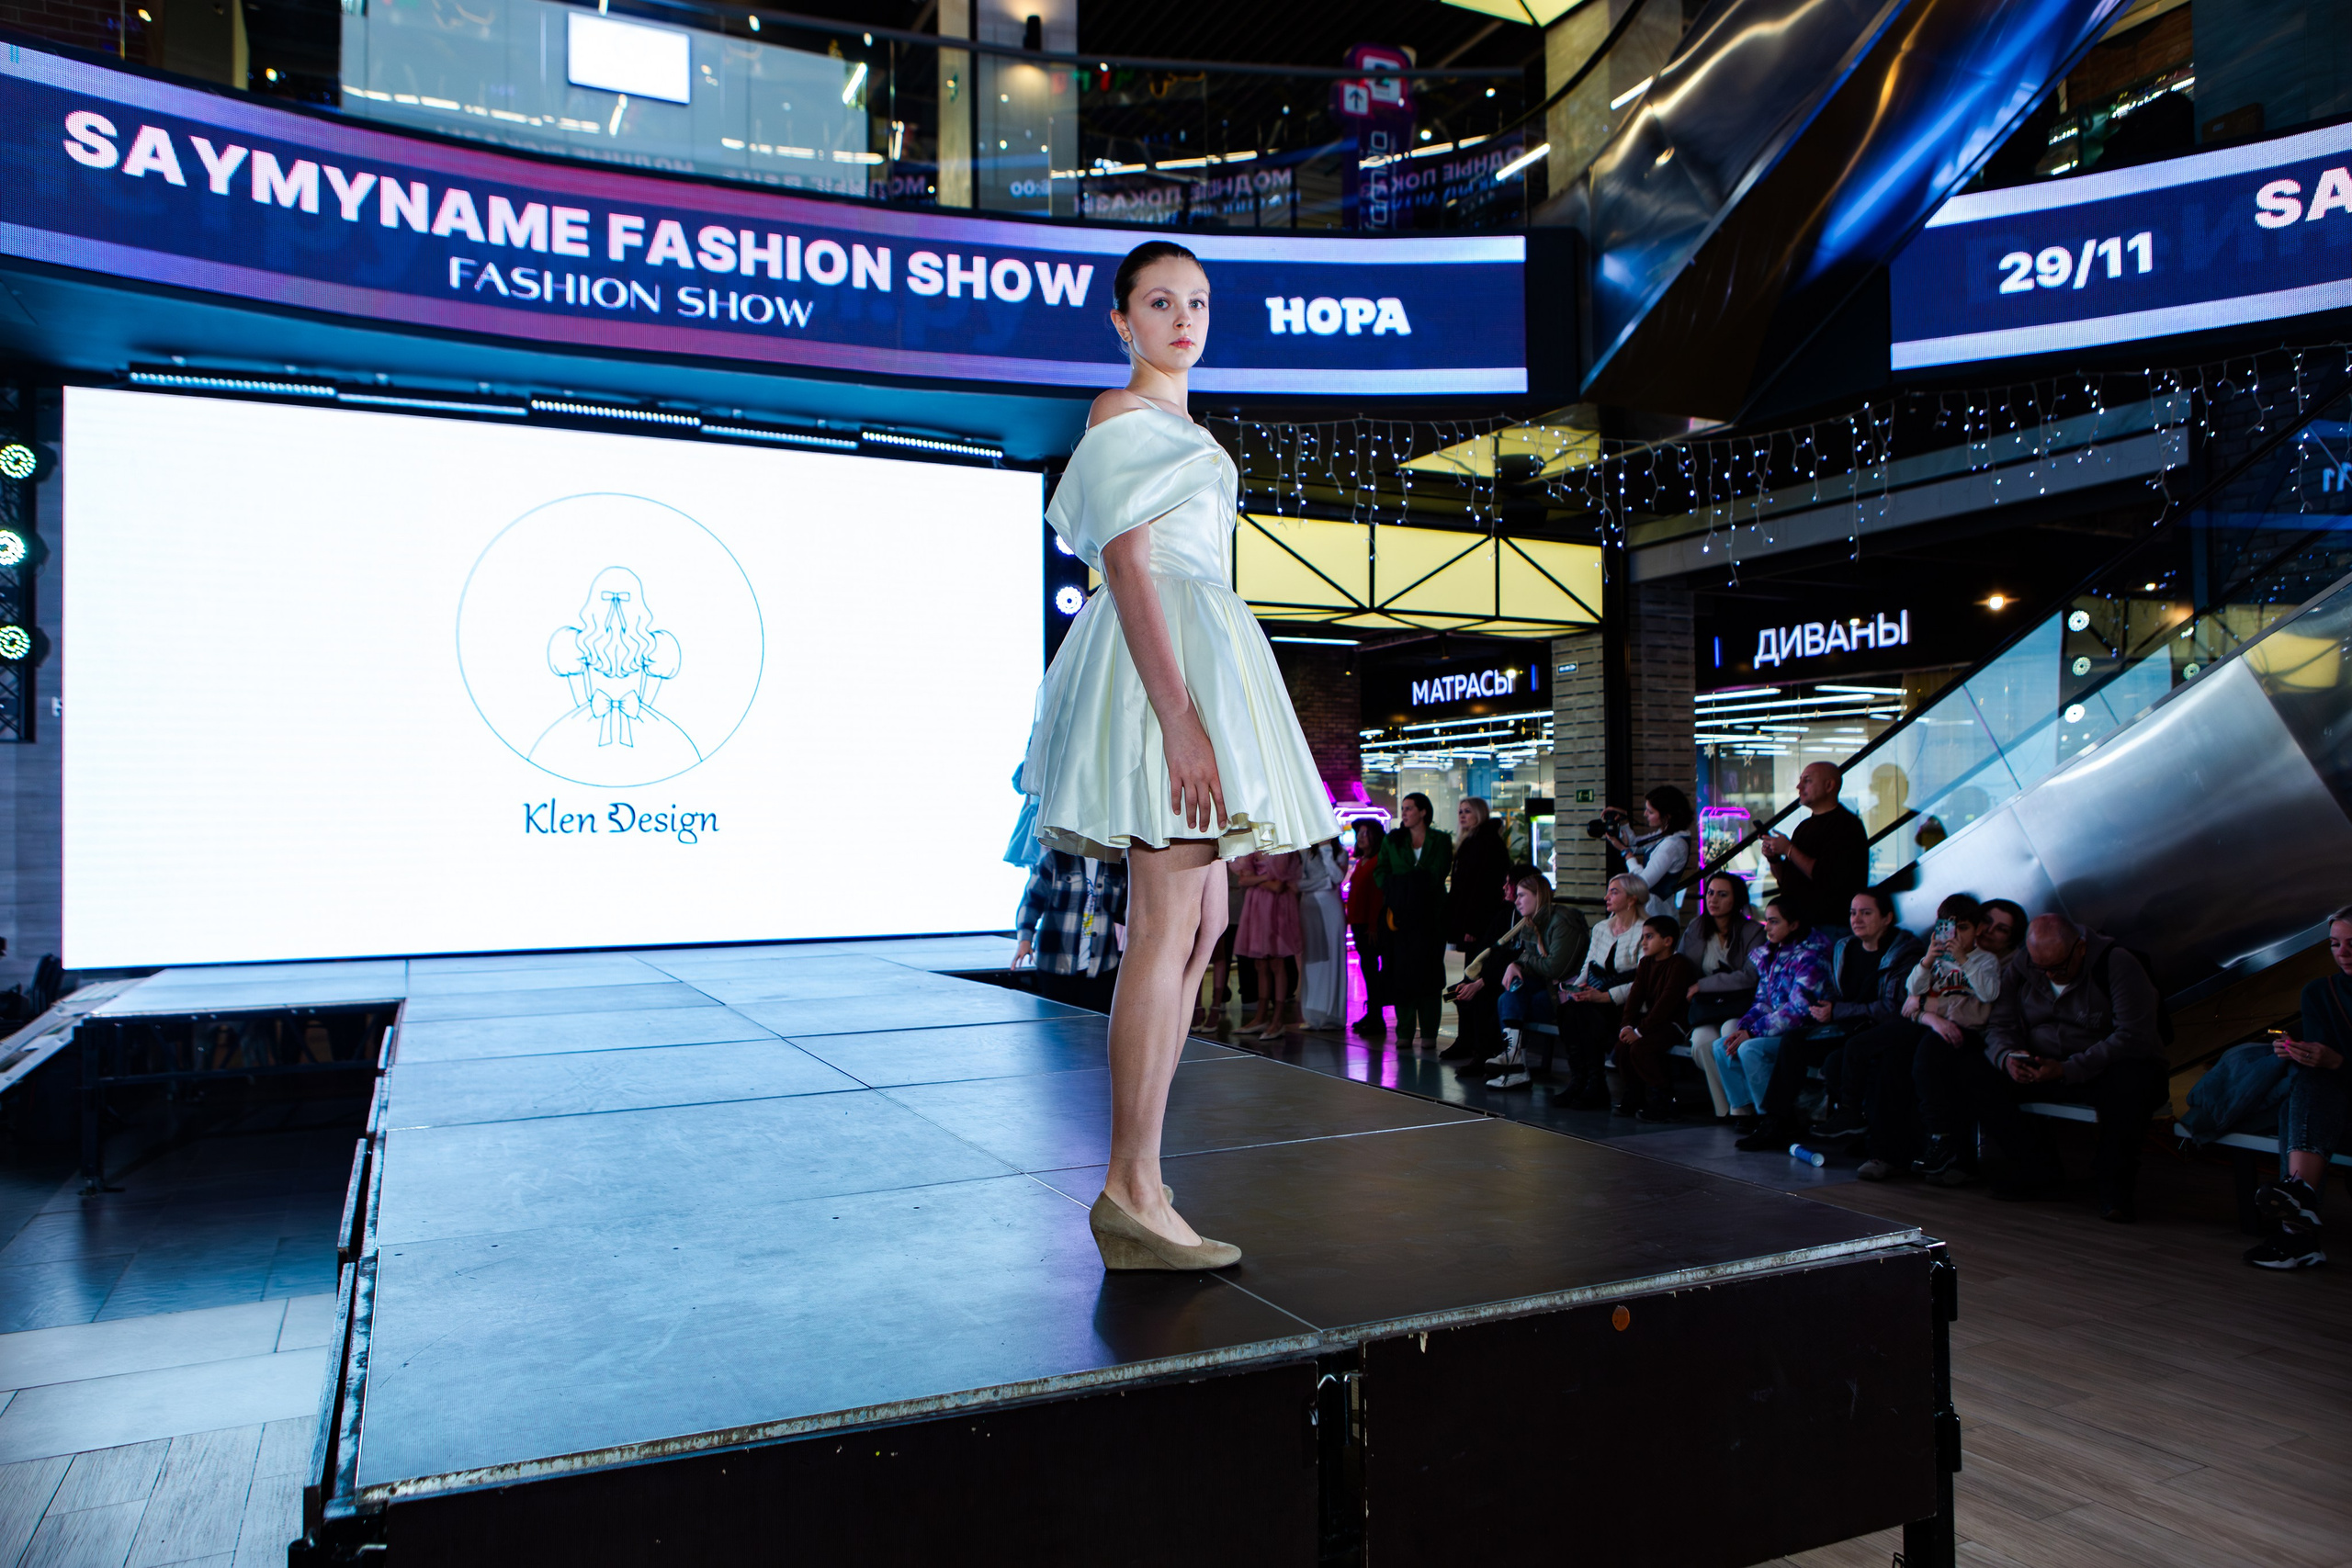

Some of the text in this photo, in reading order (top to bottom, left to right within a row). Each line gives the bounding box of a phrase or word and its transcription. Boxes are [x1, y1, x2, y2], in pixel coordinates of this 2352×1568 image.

[63, 110, 1093, 308] SAYMYNAME FASHION SHOW
[449, 255, 813, 329] FASHION SHOW
[1998, 231, 2153, 295] 29/11
[1753, 609, 1909, 670] ДИВАНЫ
[1412, 669, 1515, 706] МАТРАСЫ
[523, 797, 720, 844] Klen Design
